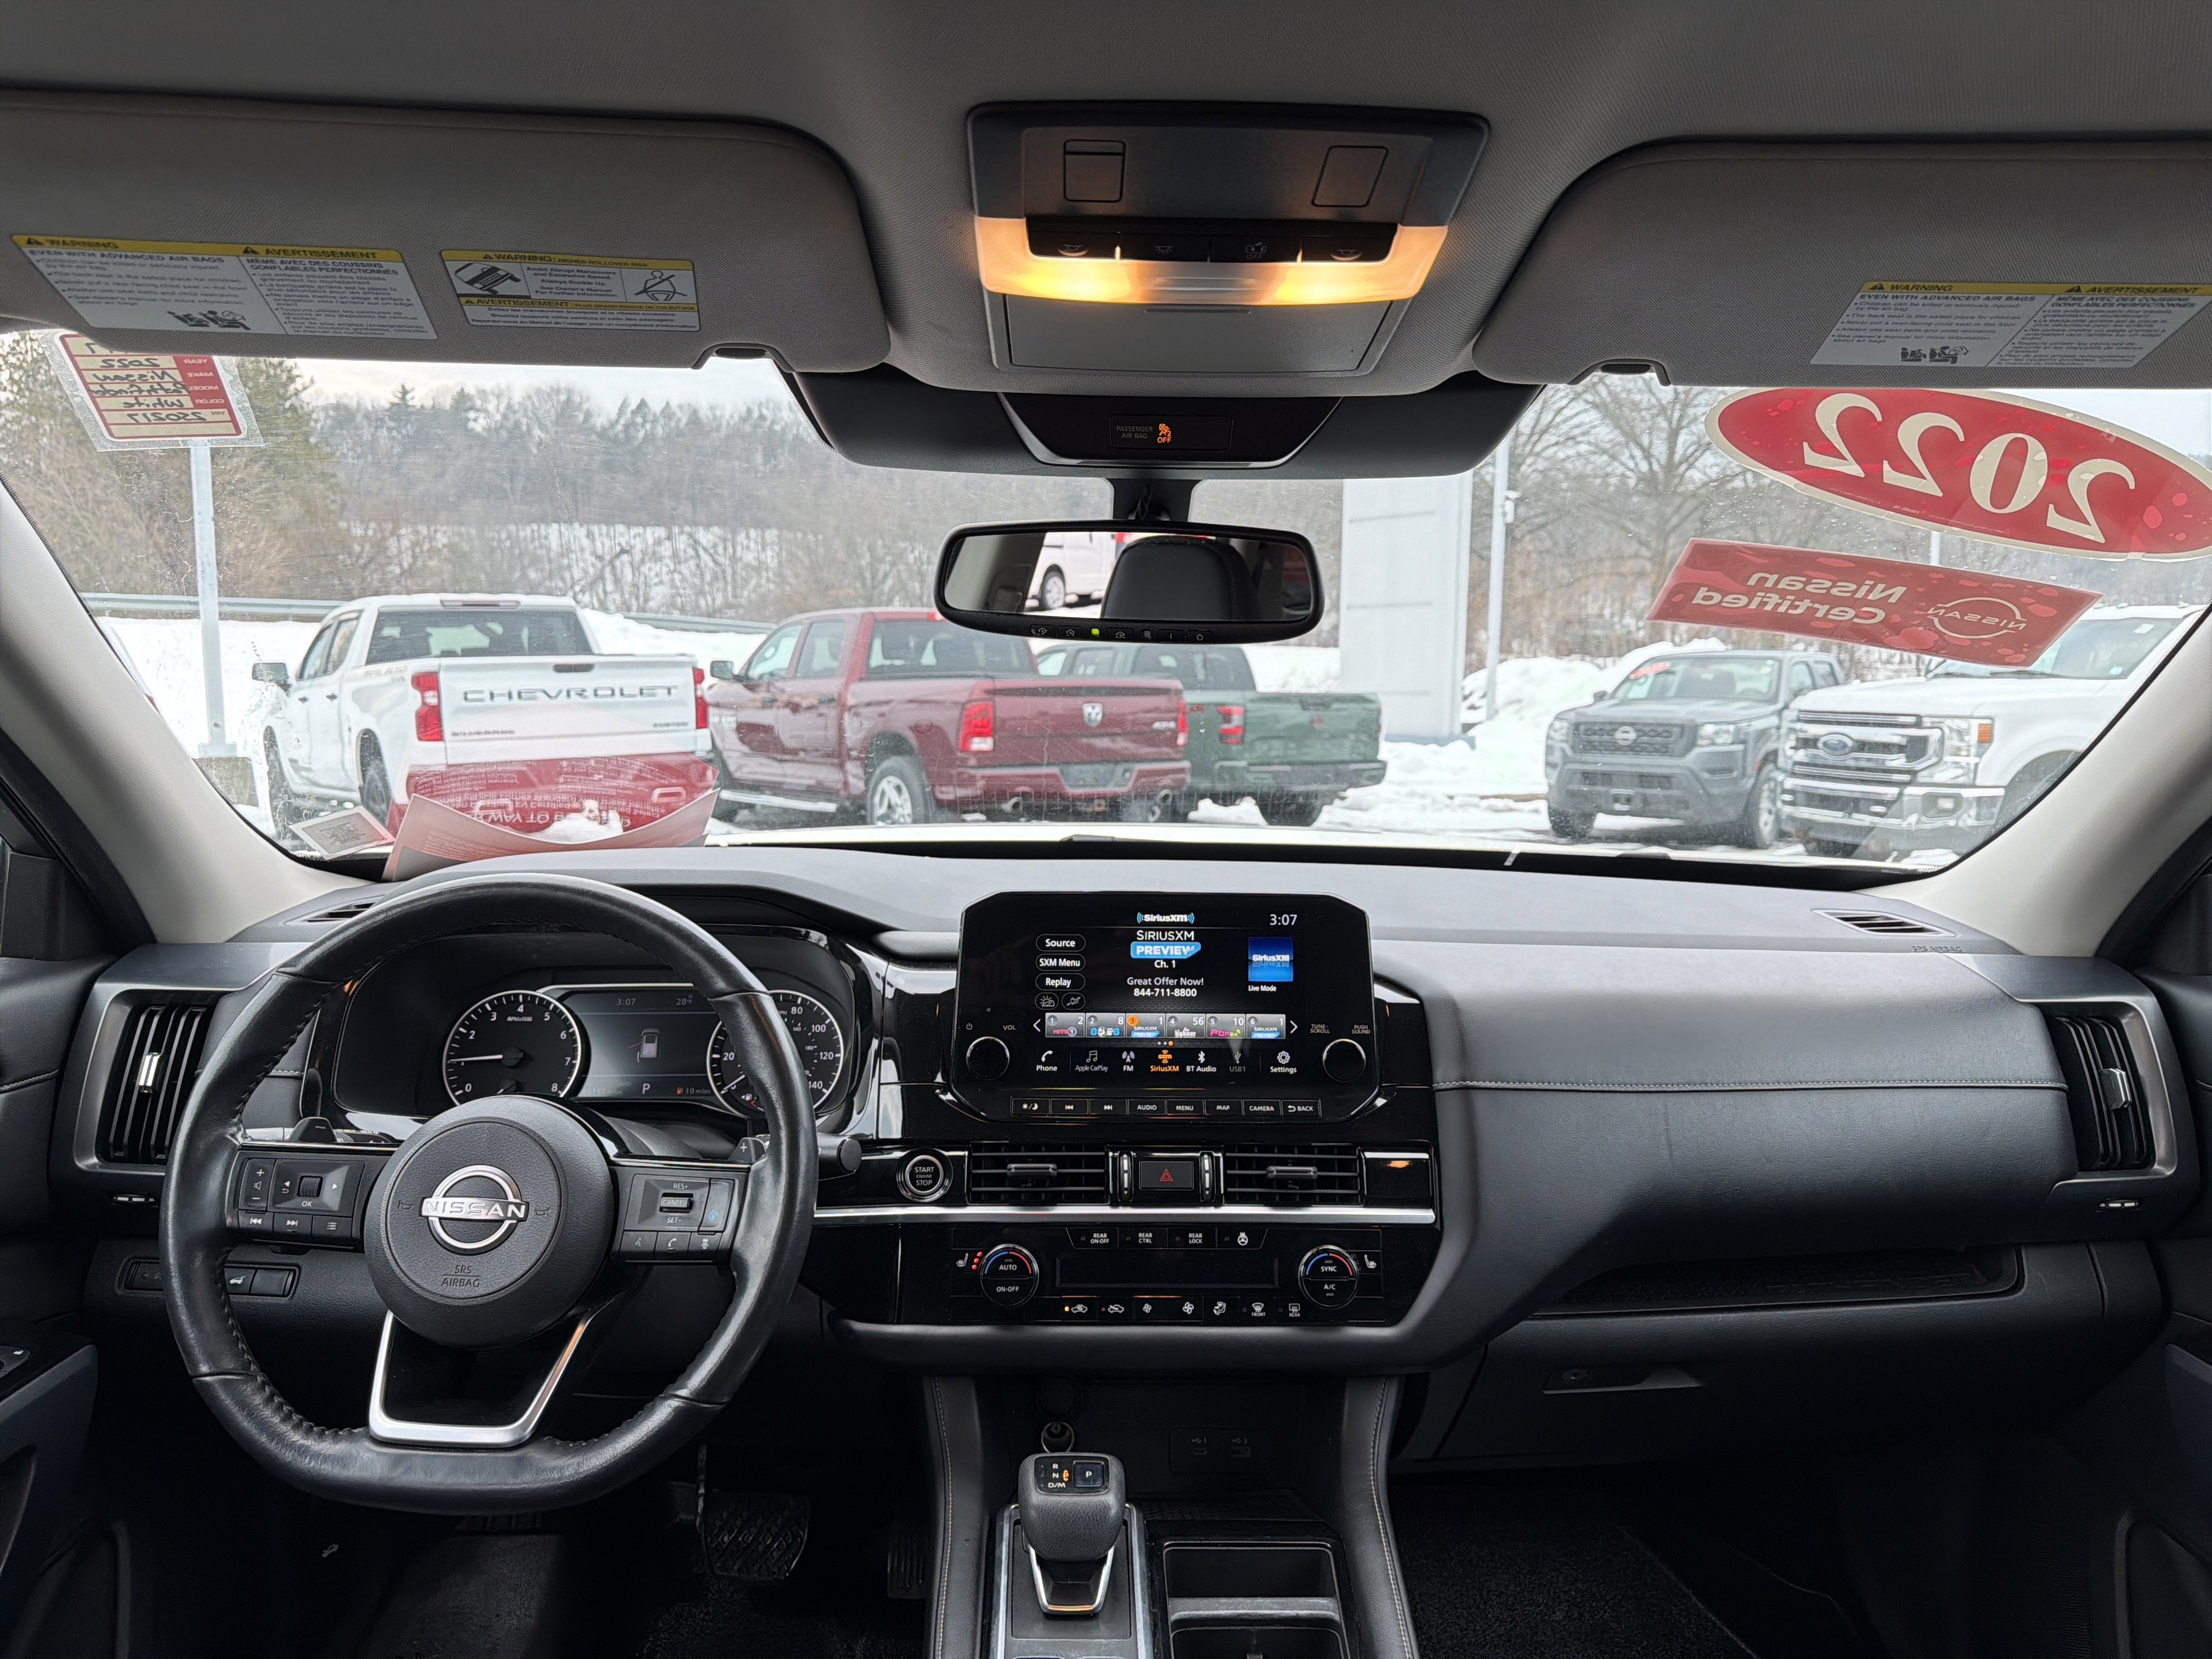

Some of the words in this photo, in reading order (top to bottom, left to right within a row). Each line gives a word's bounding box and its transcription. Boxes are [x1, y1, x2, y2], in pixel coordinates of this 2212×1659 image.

[46, 239, 119, 249] WARNING
[101, 252, 165, 261] ADVANCED
[265, 249, 377, 258] AVERTISSEMENT
[463, 685, 679, 703] CHEVROLET
[1269, 913, 1297, 926] 3:07
[1136, 930, 1194, 940] SIRIUSXM
[1045, 938, 1076, 947] Source
[1136, 945, 1195, 955] PREVIEW
[1039, 958, 1057, 967] SXM
[1059, 958, 1080, 967] Menu
[1154, 960, 1169, 968] Ch.
[1172, 960, 1176, 968] 1
[1046, 977, 1071, 988] Replay
[1127, 977, 1152, 986] Great
[1154, 977, 1178, 986] Offer
[1180, 977, 1204, 986] Now!
[1133, 988, 1197, 997] 844-711-8800
[617, 998, 636, 1006] 3:07
[517, 1004, 524, 1013] 4
[791, 1006, 803, 1014] 80
[490, 1012, 497, 1021] 3
[544, 1012, 550, 1021] 5
[1077, 1017, 1084, 1025] 2
[1118, 1017, 1124, 1025] 8
[1159, 1017, 1163, 1025] 1
[1193, 1017, 1204, 1026] 56
[1233, 1018, 1244, 1026] 10
[1279, 1018, 1284, 1026] 1
[811, 1024, 826, 1032] 100
[469, 1030, 476, 1040] 2
[560, 1030, 567, 1040] 6
[723, 1052, 735, 1060] 20
[819, 1051, 834, 1060] 120
[565, 1057, 571, 1066] 7
[1270, 1066, 1297, 1074] Settings
[465, 1084, 472, 1092] 0
[551, 1082, 558, 1092] 8
[642, 1083, 651, 1094] P
[809, 1080, 823, 1089] 140
[424, 1201, 526, 1218] NISSAN
[454, 1264, 472, 1274] SRS
[441, 1277, 481, 1288] AIRBAG
